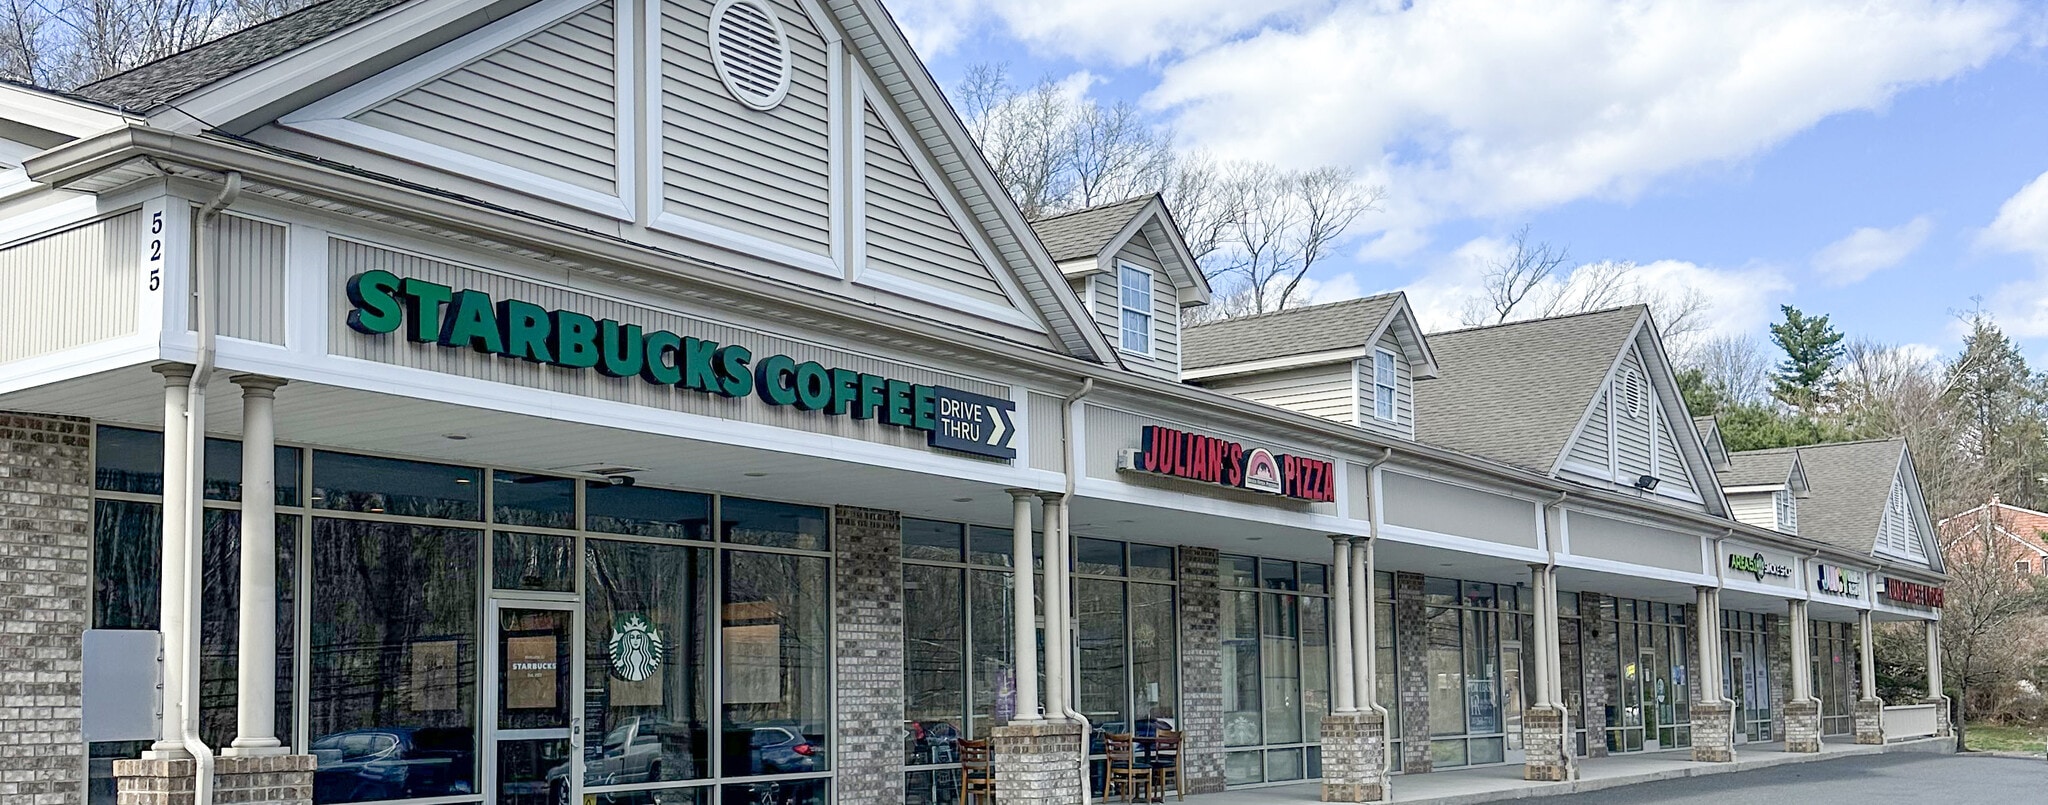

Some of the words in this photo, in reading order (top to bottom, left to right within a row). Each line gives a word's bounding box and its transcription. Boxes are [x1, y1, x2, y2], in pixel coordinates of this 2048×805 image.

[151, 210, 163, 292] 525
[348, 269, 754, 398] STARBUCKS
[757, 354, 936, 430] COFFEE
[940, 397, 983, 422] DRIVE
[940, 418, 980, 442] THRU
[1144, 425, 1243, 487] JULIAN'S
[1284, 454, 1335, 503] PIZZA
[512, 662, 556, 671] STARBUCKS
